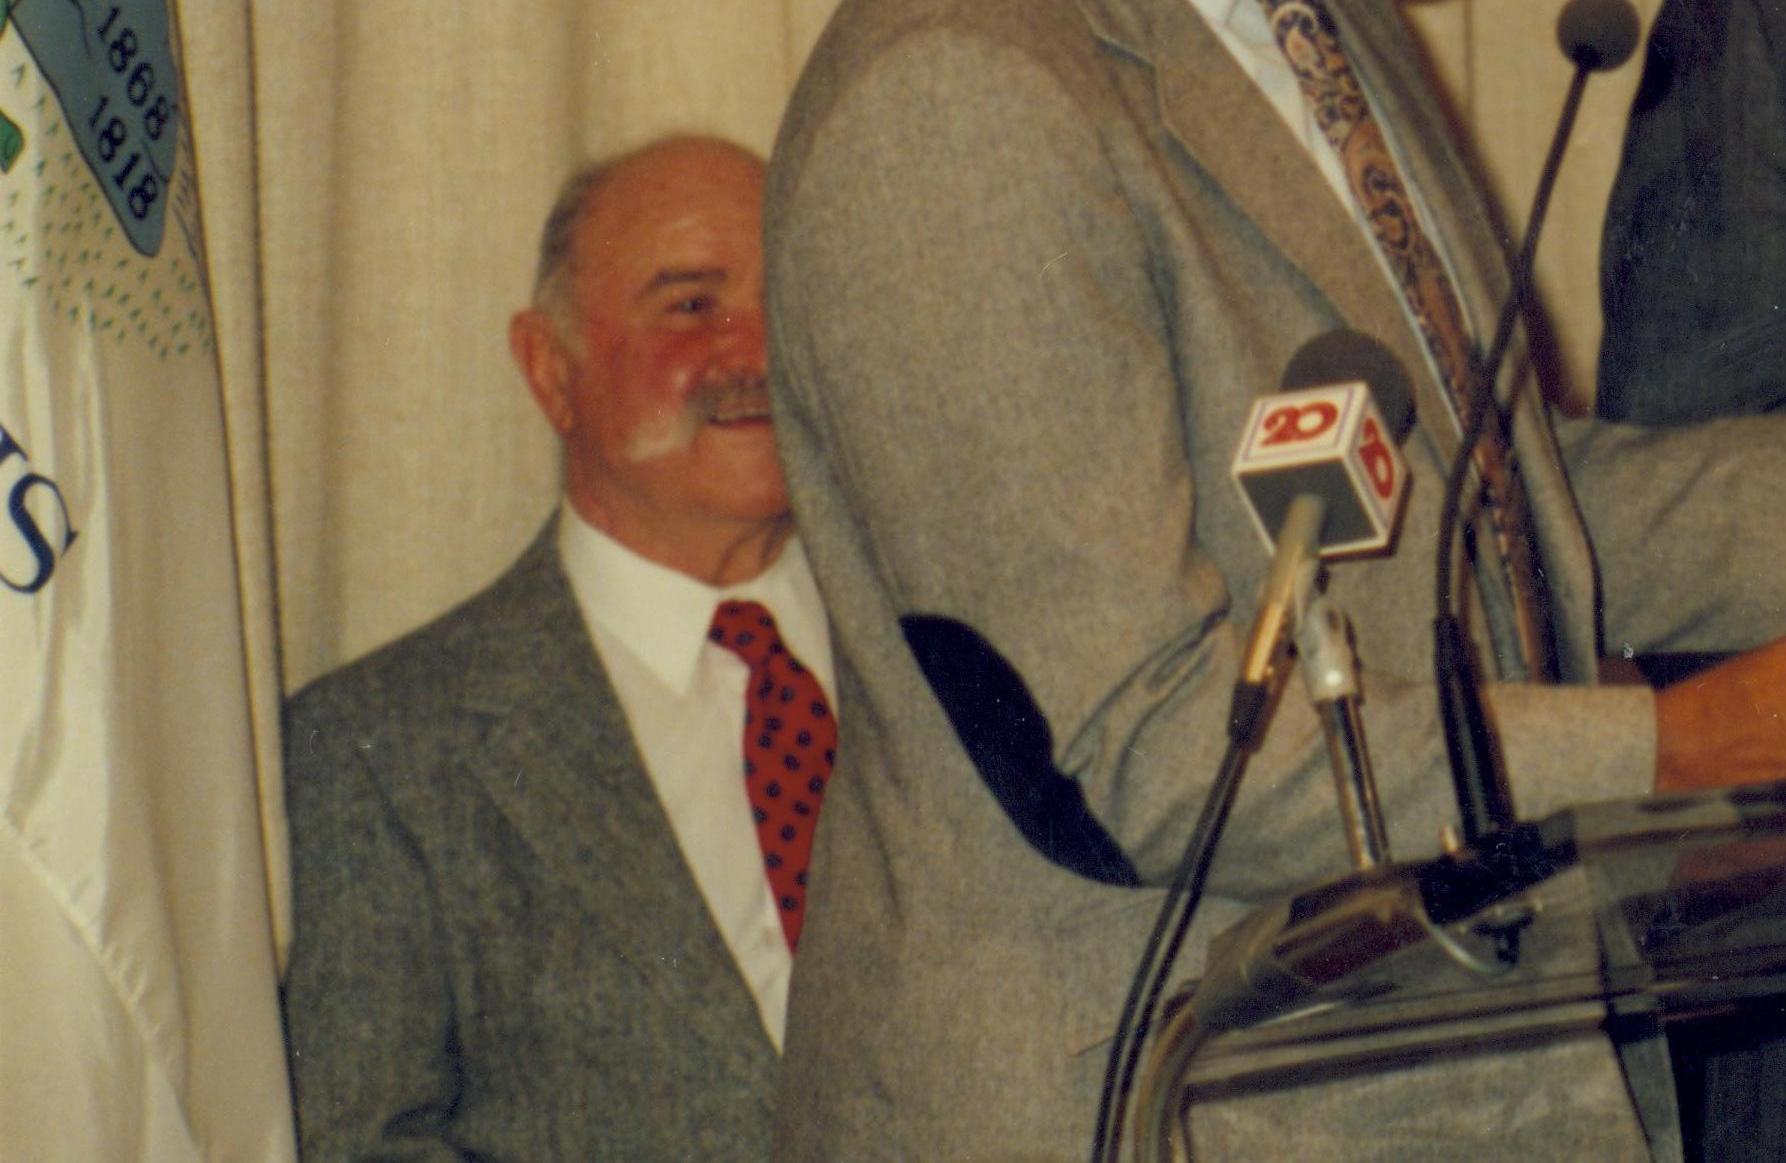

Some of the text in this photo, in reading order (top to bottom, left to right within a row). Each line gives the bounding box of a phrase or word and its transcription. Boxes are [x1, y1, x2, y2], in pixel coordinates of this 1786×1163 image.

[98, 6, 169, 140] 1868
[89, 96, 158, 220] 1818
[1260, 401, 1338, 447] 20
